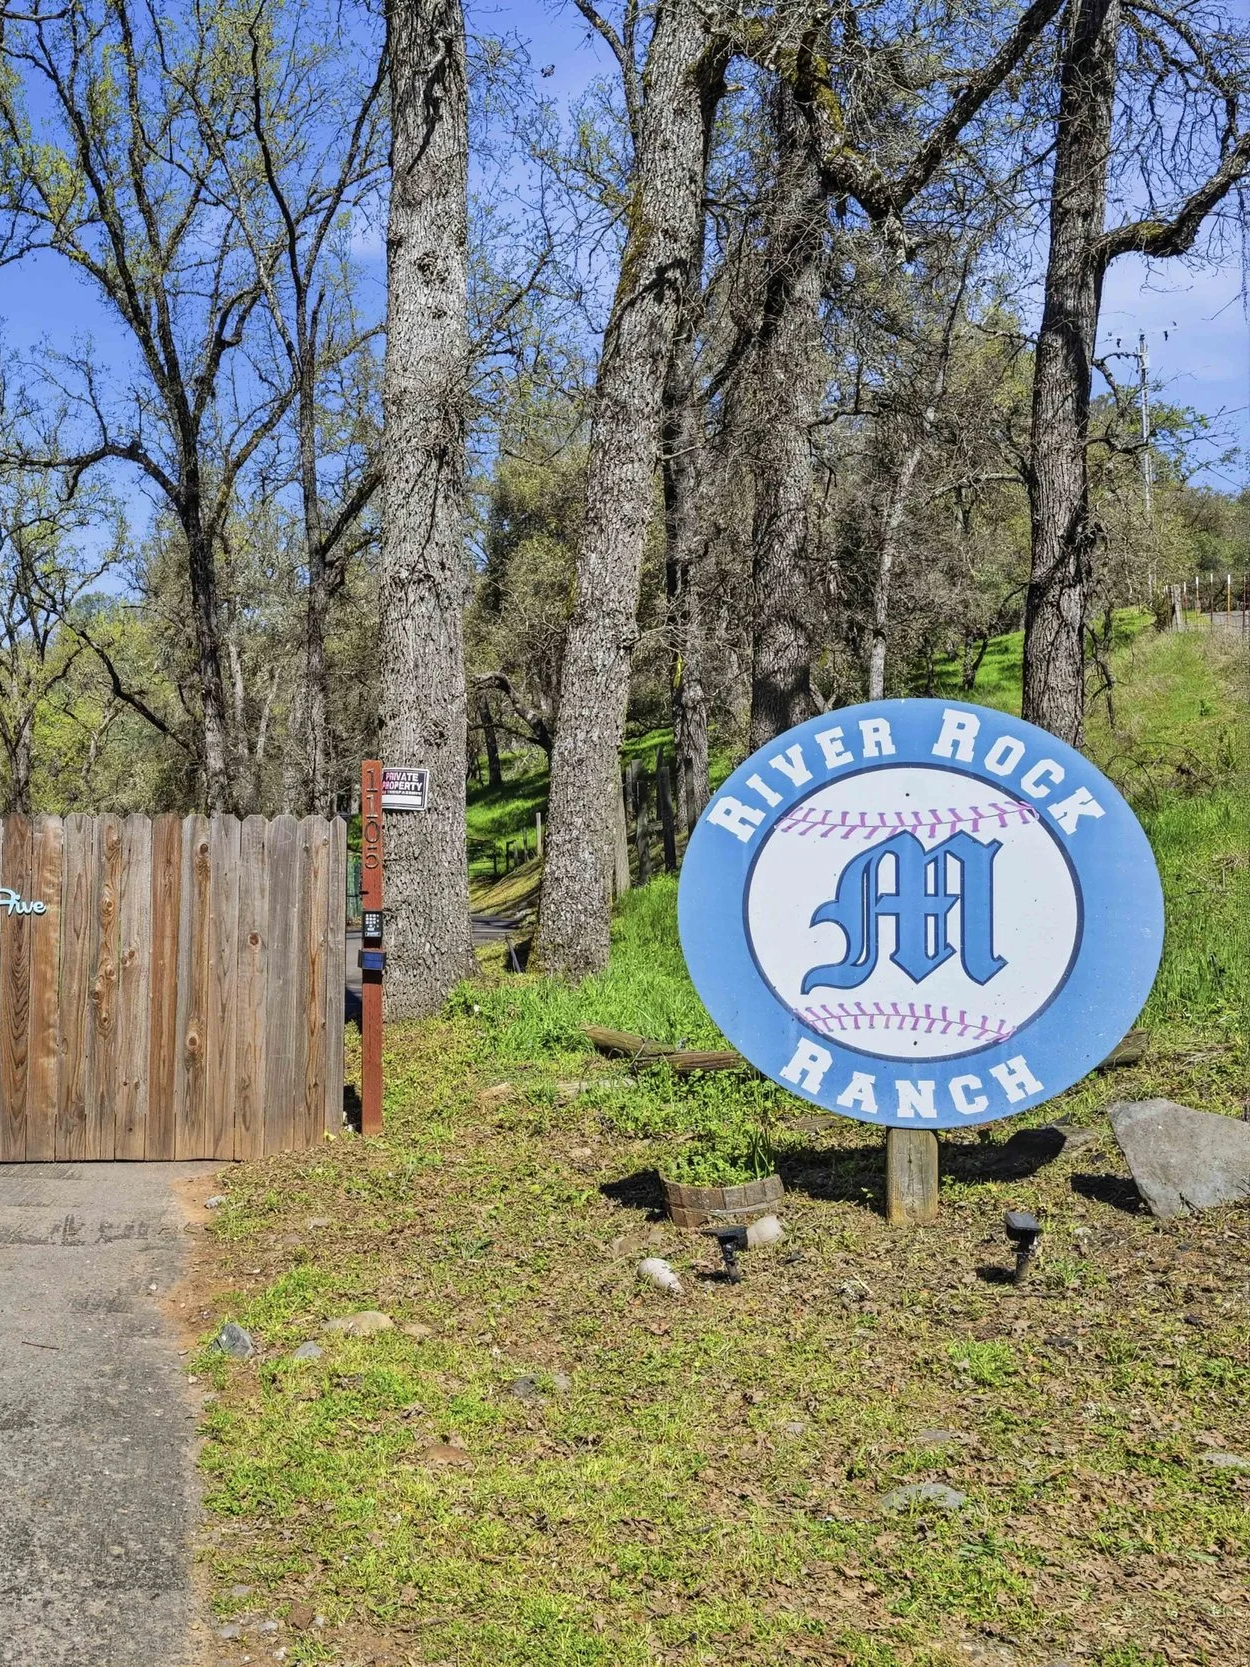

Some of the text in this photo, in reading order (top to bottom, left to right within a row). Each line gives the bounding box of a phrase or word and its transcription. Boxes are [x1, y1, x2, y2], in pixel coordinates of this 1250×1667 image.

[364, 769, 380, 870] 1105
[382, 781, 423, 791] PROPERTY
[385, 772, 419, 782] PRIVATE
[706, 708, 1107, 843] RIVER ROCK
[800, 829, 1010, 996] M
[779, 1037, 1046, 1118] RANCH
